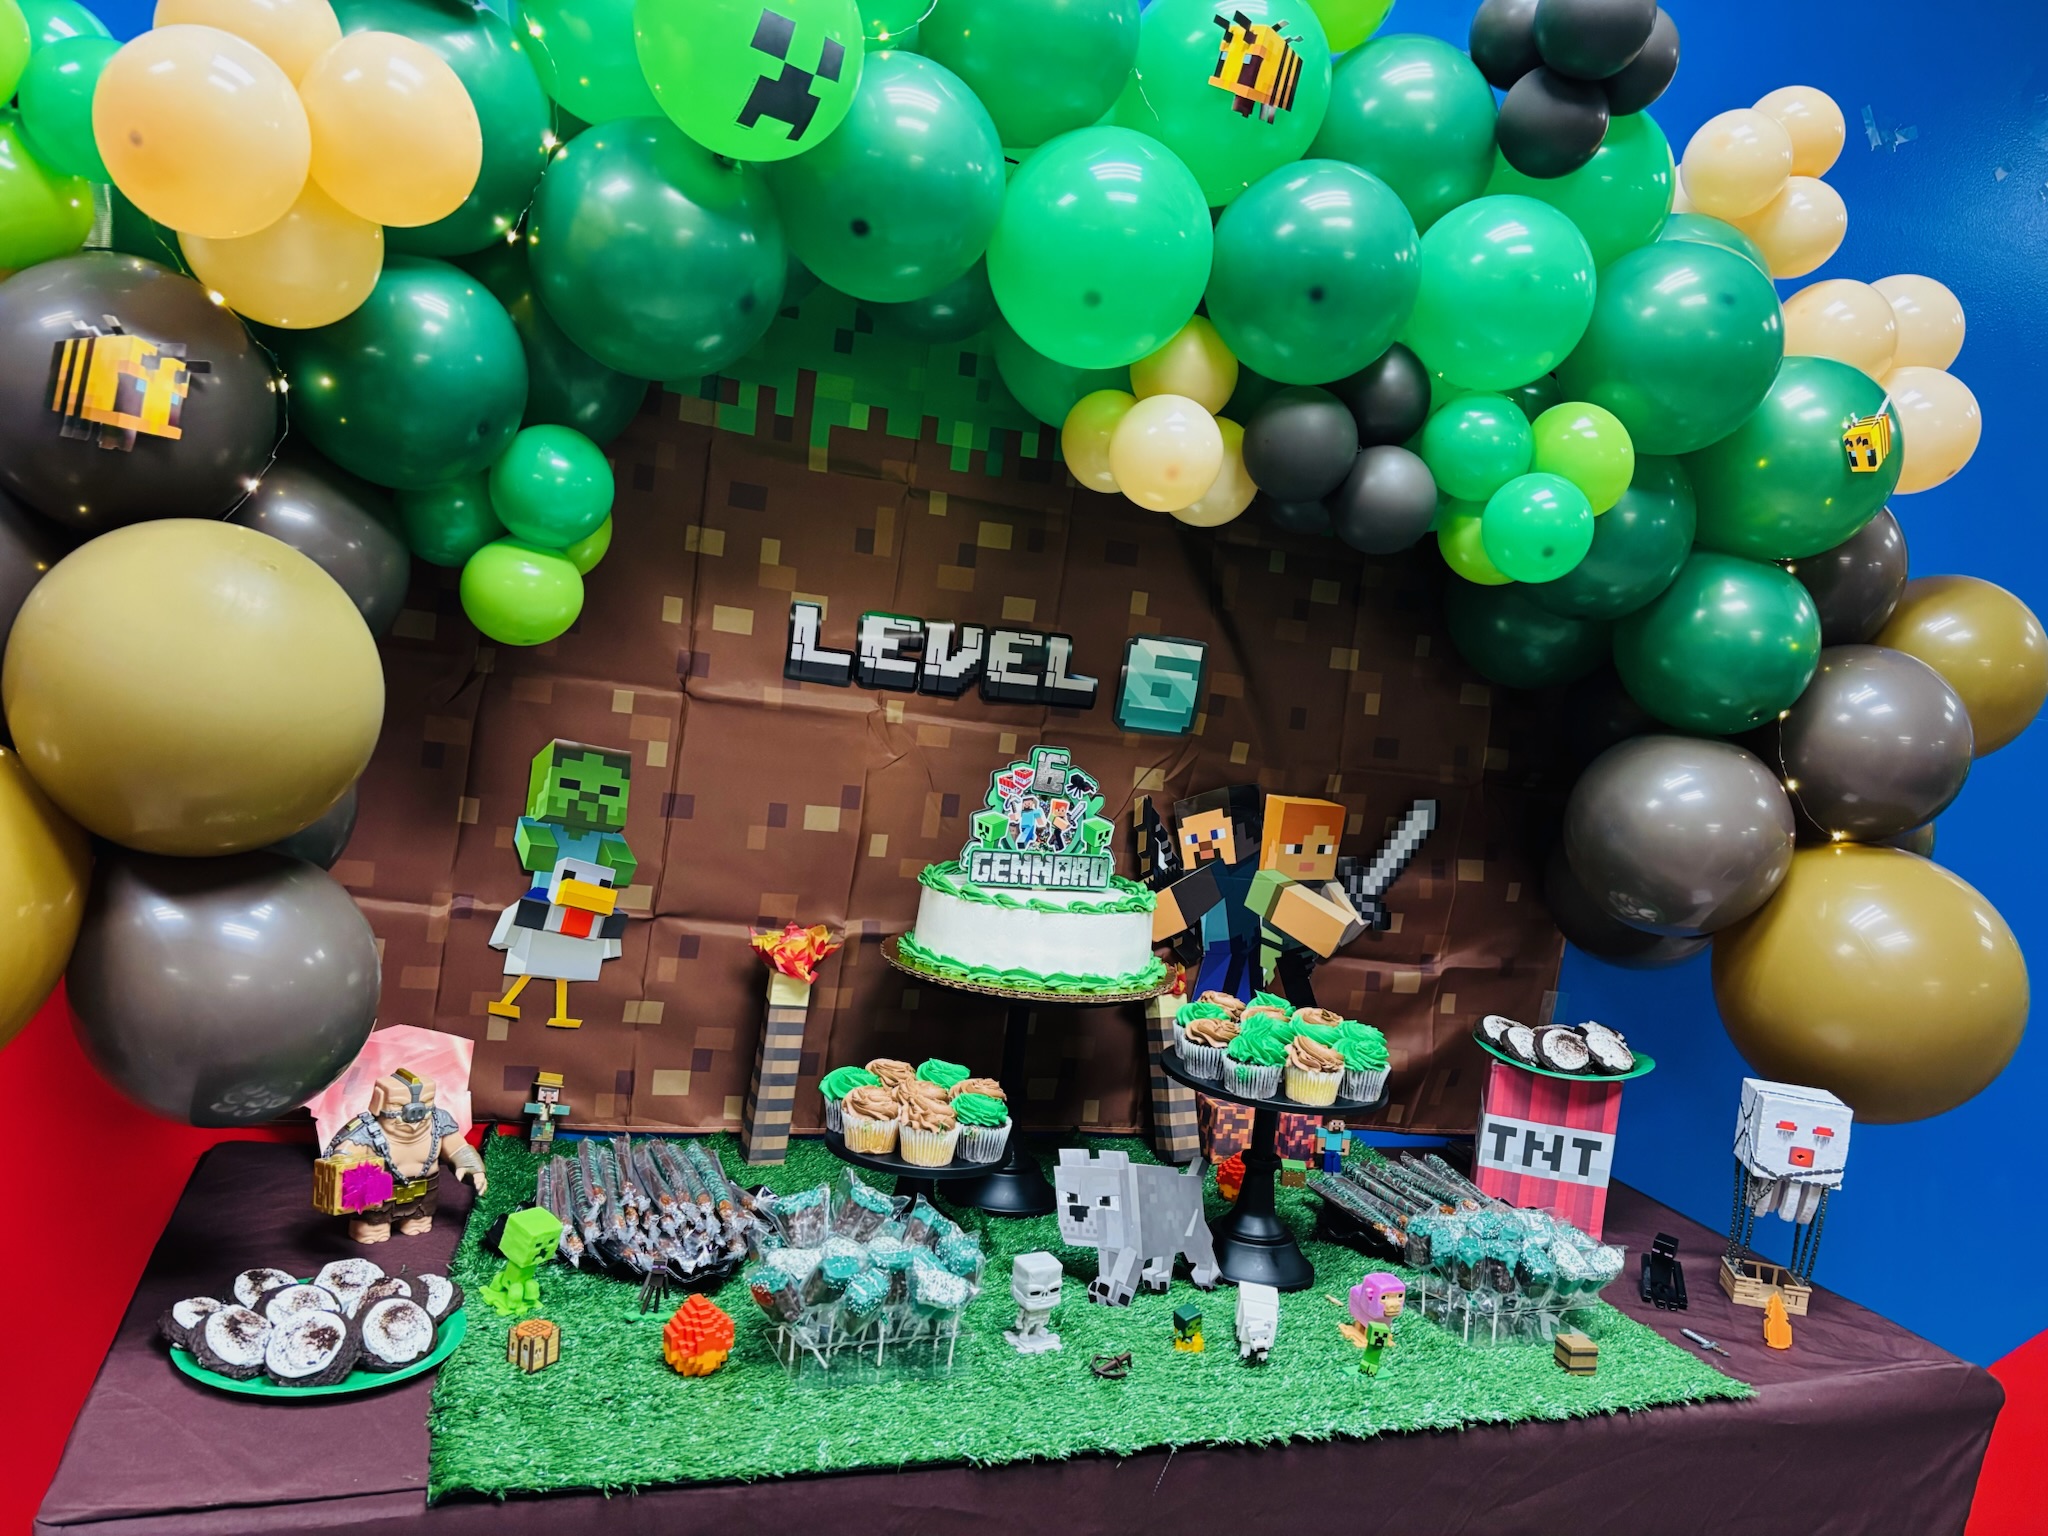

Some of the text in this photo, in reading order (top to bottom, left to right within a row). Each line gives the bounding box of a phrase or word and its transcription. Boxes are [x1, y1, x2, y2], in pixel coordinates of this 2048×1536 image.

[1114, 635, 1207, 733] 6
[1033, 751, 1070, 795] 6
[971, 851, 1110, 888] GENNARO
[1488, 1122, 1602, 1177] TNT
